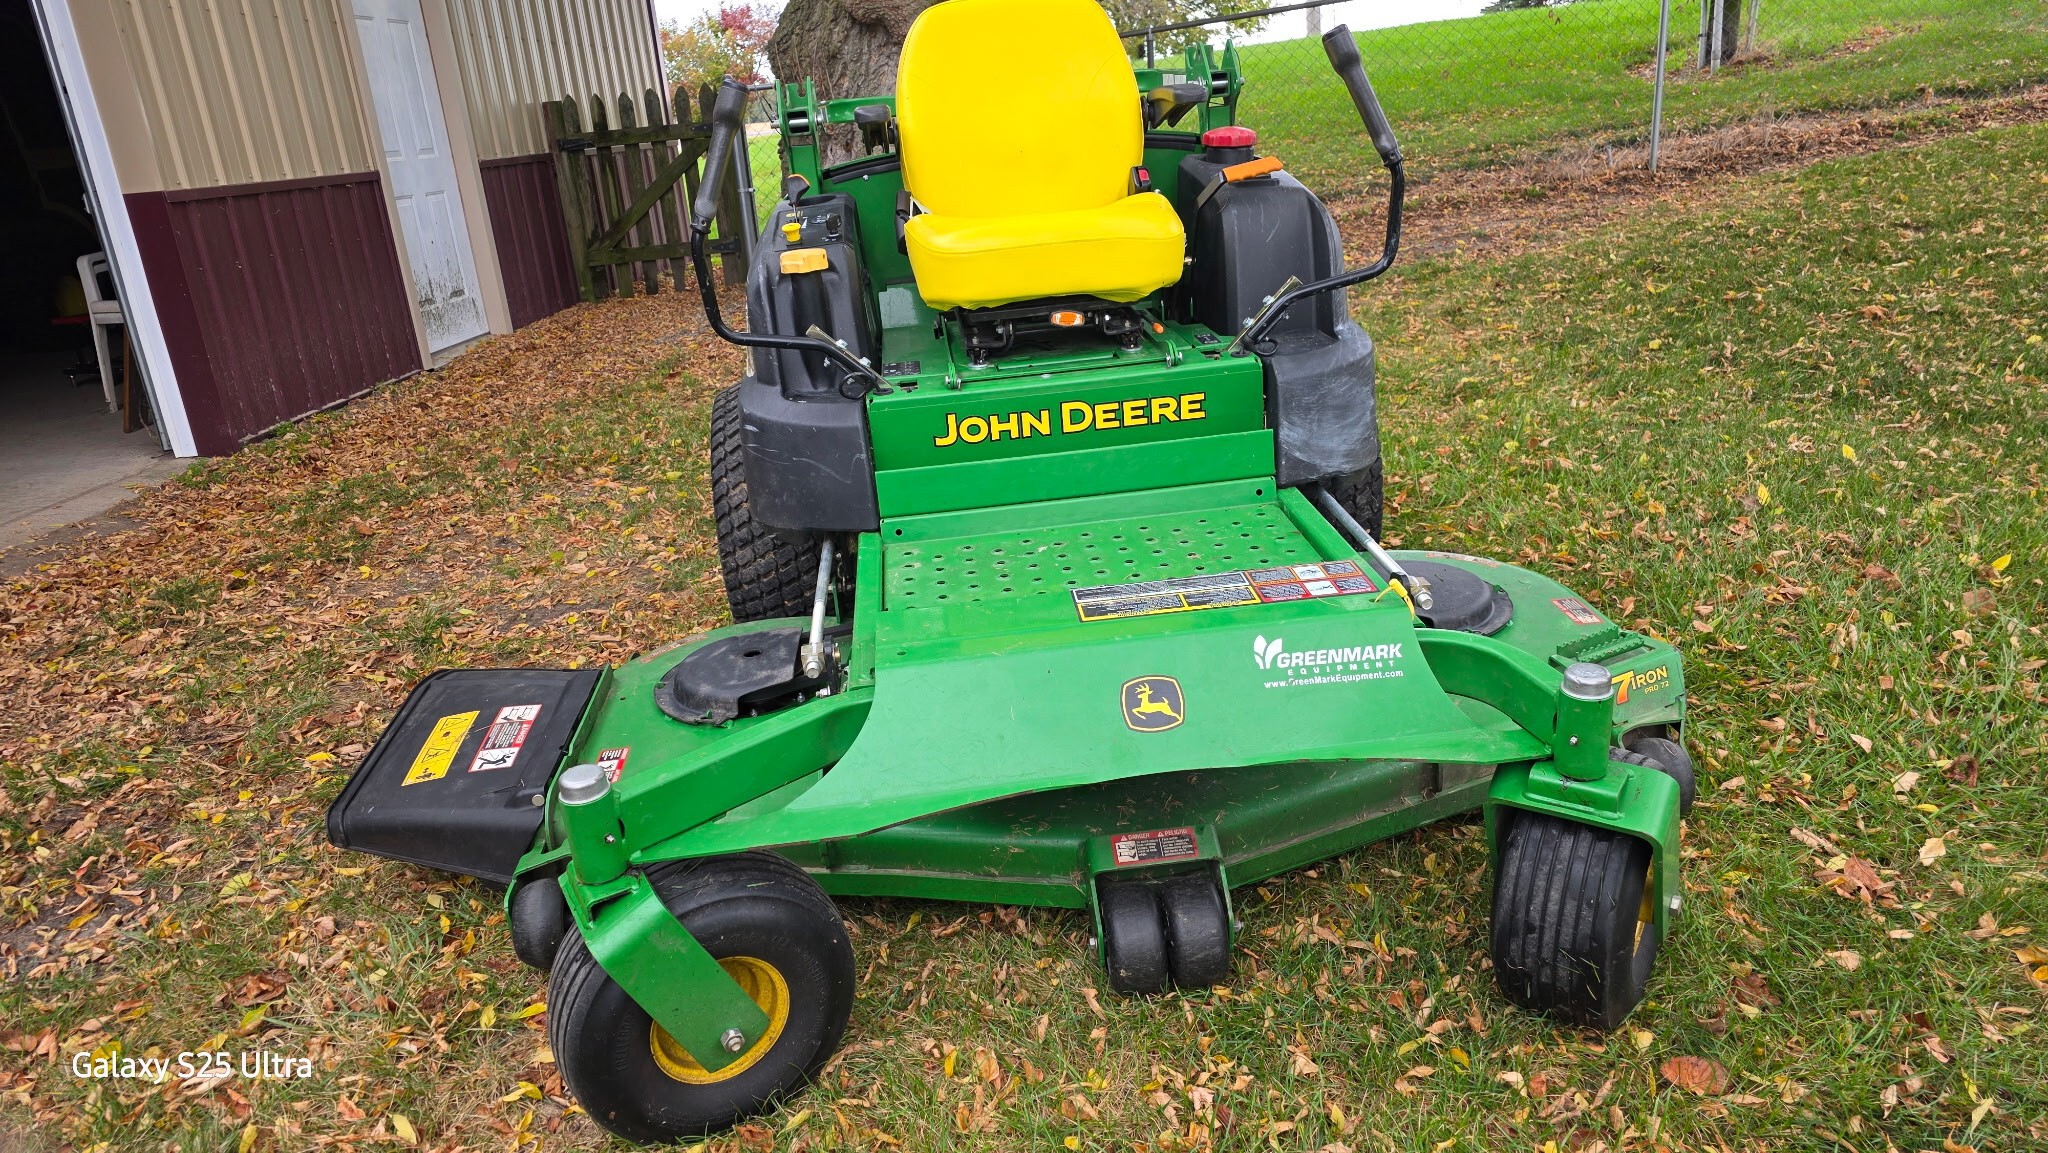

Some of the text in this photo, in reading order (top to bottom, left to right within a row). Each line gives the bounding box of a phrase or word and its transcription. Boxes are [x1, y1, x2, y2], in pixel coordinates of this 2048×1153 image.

[934, 392, 1206, 447] JOHN DEERE
[1277, 643, 1403, 668] GREENMARK
[1288, 660, 1394, 675] EQUIPMENT
[1264, 670, 1404, 689] www.GreenMarkEquipment.com
[1644, 680, 1669, 695] PRO 72
